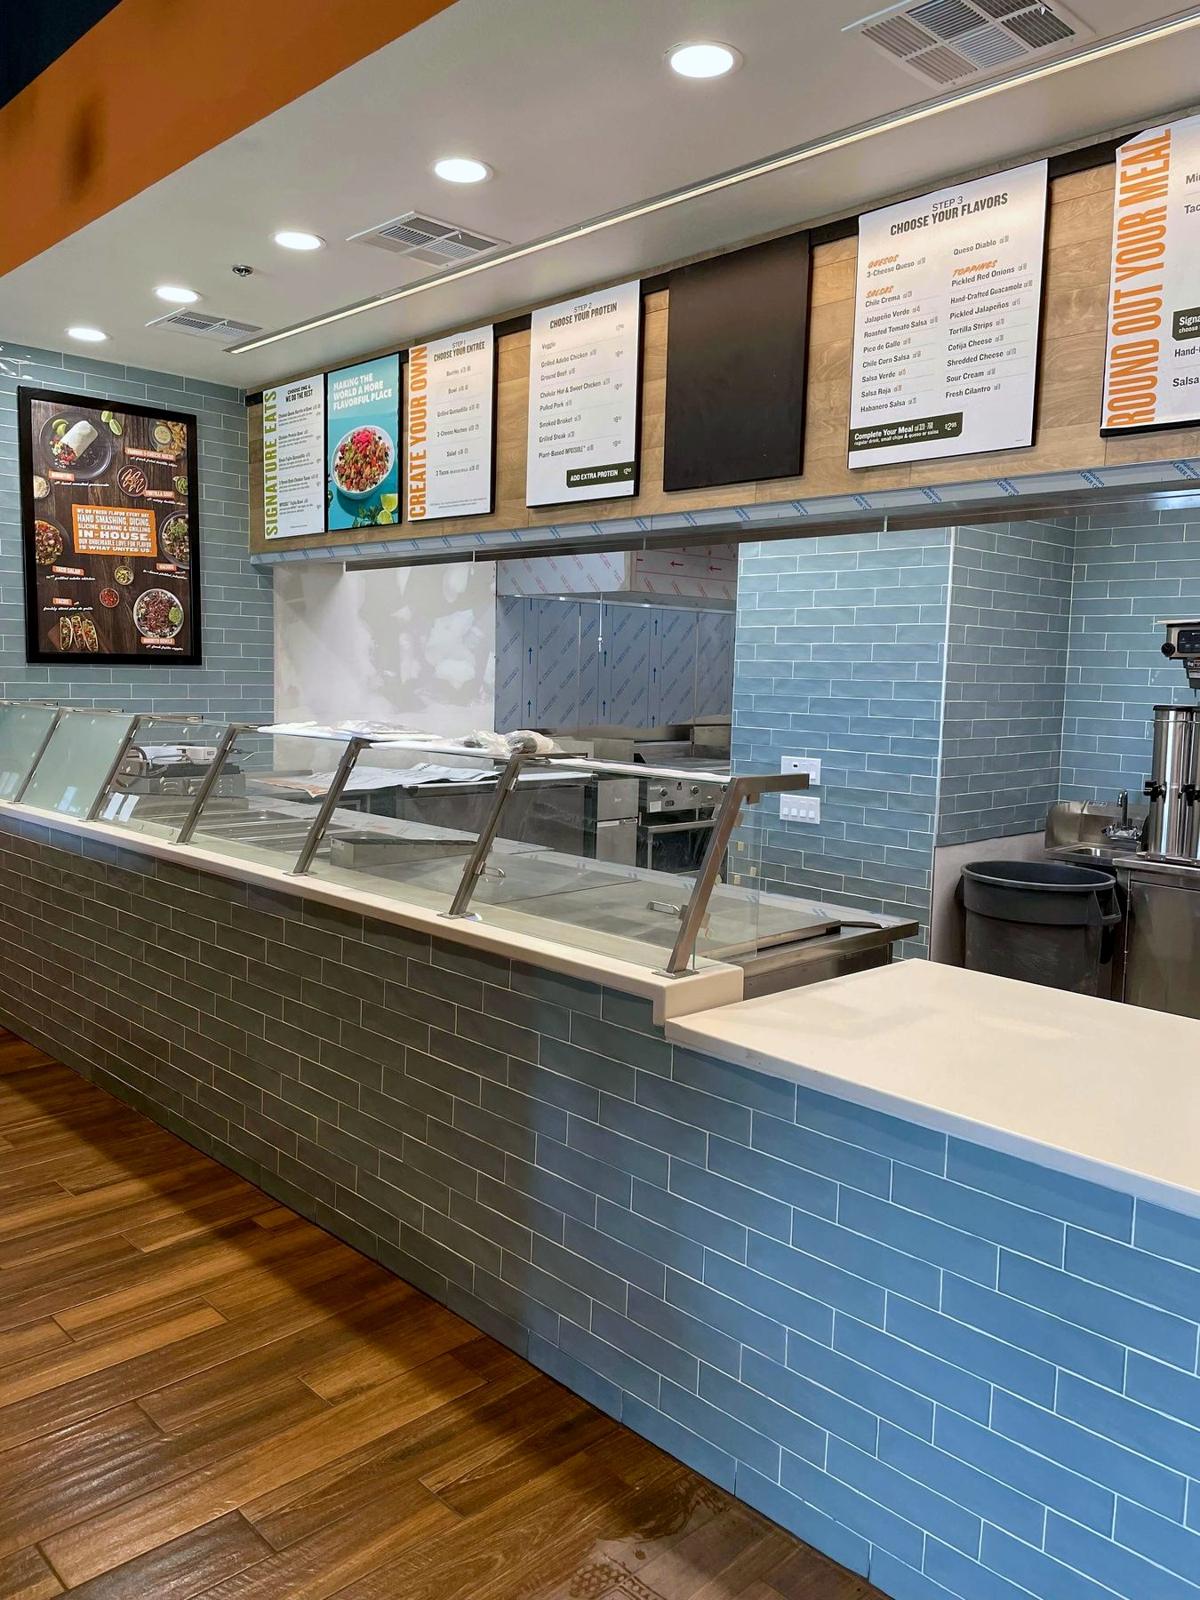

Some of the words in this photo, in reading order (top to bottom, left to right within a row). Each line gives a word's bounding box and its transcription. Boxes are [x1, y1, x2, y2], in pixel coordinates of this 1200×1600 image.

[1119, 128, 1171, 207] MEAL
[932, 198, 955, 212] STEP
[958, 196, 964, 204] 3
[890, 215, 930, 236] CHOOSE
[932, 206, 958, 224] YOUR
[961, 192, 1008, 216] FLAVORS
[954, 246, 974, 256] Queso
[976, 240, 996, 250] Diablo
[1115, 205, 1167, 283] YOUR
[896, 262, 914, 271] Queso
[953, 260, 997, 277] TOPPINGS
[952, 276, 975, 287] Pickled
[976, 272, 989, 281] Red
[992, 267, 1015, 277] Onions
[864, 297, 879, 307] Chile
[881, 294, 900, 304] Crema
[950, 290, 989, 304] Hand-Crafted
[990, 282, 1022, 295] Guacamole
[550, 315, 572, 329] CHOOSE
[574, 310, 590, 323] YOUR
[591, 302, 618, 319] PROTEIN
[574, 304, 588, 313] STEP
[892, 309, 910, 317] Verde
[950, 309, 974, 319] Pickled
[975, 302, 1009, 314] Jalapeños
[1112, 284, 1162, 336] OUT
[864, 328, 887, 338] Roasted
[888, 324, 910, 333] Tomato
[911, 319, 927, 328] Salsa
[949, 326, 972, 335] Tortilla
[973, 322, 993, 331] Strips
[886, 340, 900, 349] Gallo
[948, 342, 966, 351] Cotija
[968, 338, 992, 347] Cheese
[434, 350, 452, 362] CHOOSE
[453, 347, 465, 356] YOUR
[863, 359, 877, 368] Chile
[878, 357, 892, 365] Corn
[894, 354, 910, 362] Salsa
[947, 355, 977, 367] Shredded
[979, 351, 1003, 360] Cheese
[410, 346, 427, 392] OWN
[862, 374, 877, 382] Salsa
[878, 371, 895, 380] Verde
[946, 374, 962, 382] Sour
[963, 370, 984, 380] Cream
[334, 376, 359, 390] MAKING
[360, 373, 373, 384] THE
[584, 379, 601, 389] Chicken
[1107, 339, 1159, 426] ROUND
[1173, 376, 1199, 387] Salsa
[334, 387, 357, 400] WORLD
[358, 386, 363, 394] A
[364, 380, 384, 392] MORE
[861, 389, 876, 398] Salsa
[878, 387, 891, 396] Roja
[946, 390, 963, 398] Fresh
[964, 386, 991, 395] Cilantro
[333, 394, 369, 410] FLAVORFUL
[371, 388, 392, 401] PLACE
[860, 402, 888, 412] Habanero
[889, 400, 905, 408] Salsa
[264, 391, 277, 433] EATS
[410, 394, 427, 446] YOUR
[854, 431, 882, 440] Complete
[883, 428, 897, 436] Your
[898, 424, 913, 434] Meal
[581, 472, 597, 480] EXTRA
[598, 469, 618, 478] PROTEIN
[265, 439, 278, 536] SIGNATURE
[410, 449, 426, 518] CREATE
[78, 514, 94, 523] HAND
[96, 515, 128, 525] SMASHING,
